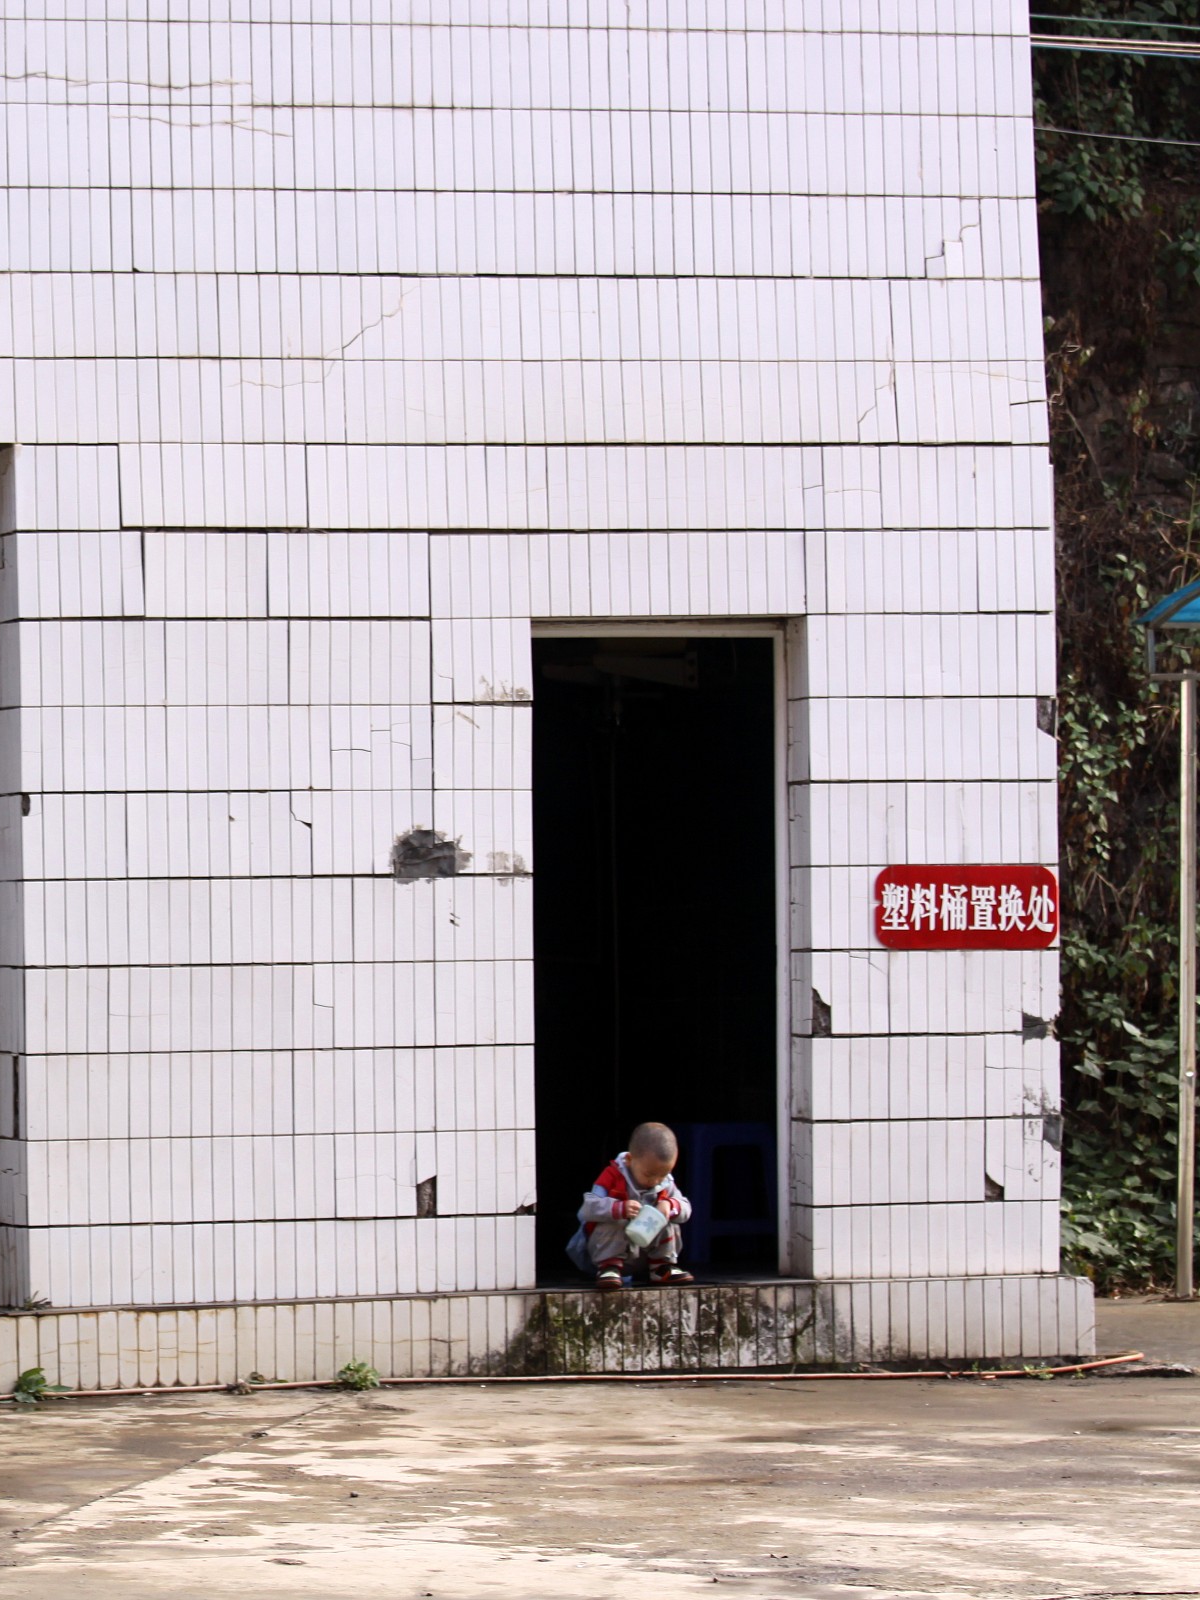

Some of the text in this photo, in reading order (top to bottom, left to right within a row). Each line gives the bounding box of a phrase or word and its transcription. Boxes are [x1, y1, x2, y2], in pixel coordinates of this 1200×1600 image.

[881, 883, 1055, 932] 塑料桶置换处
